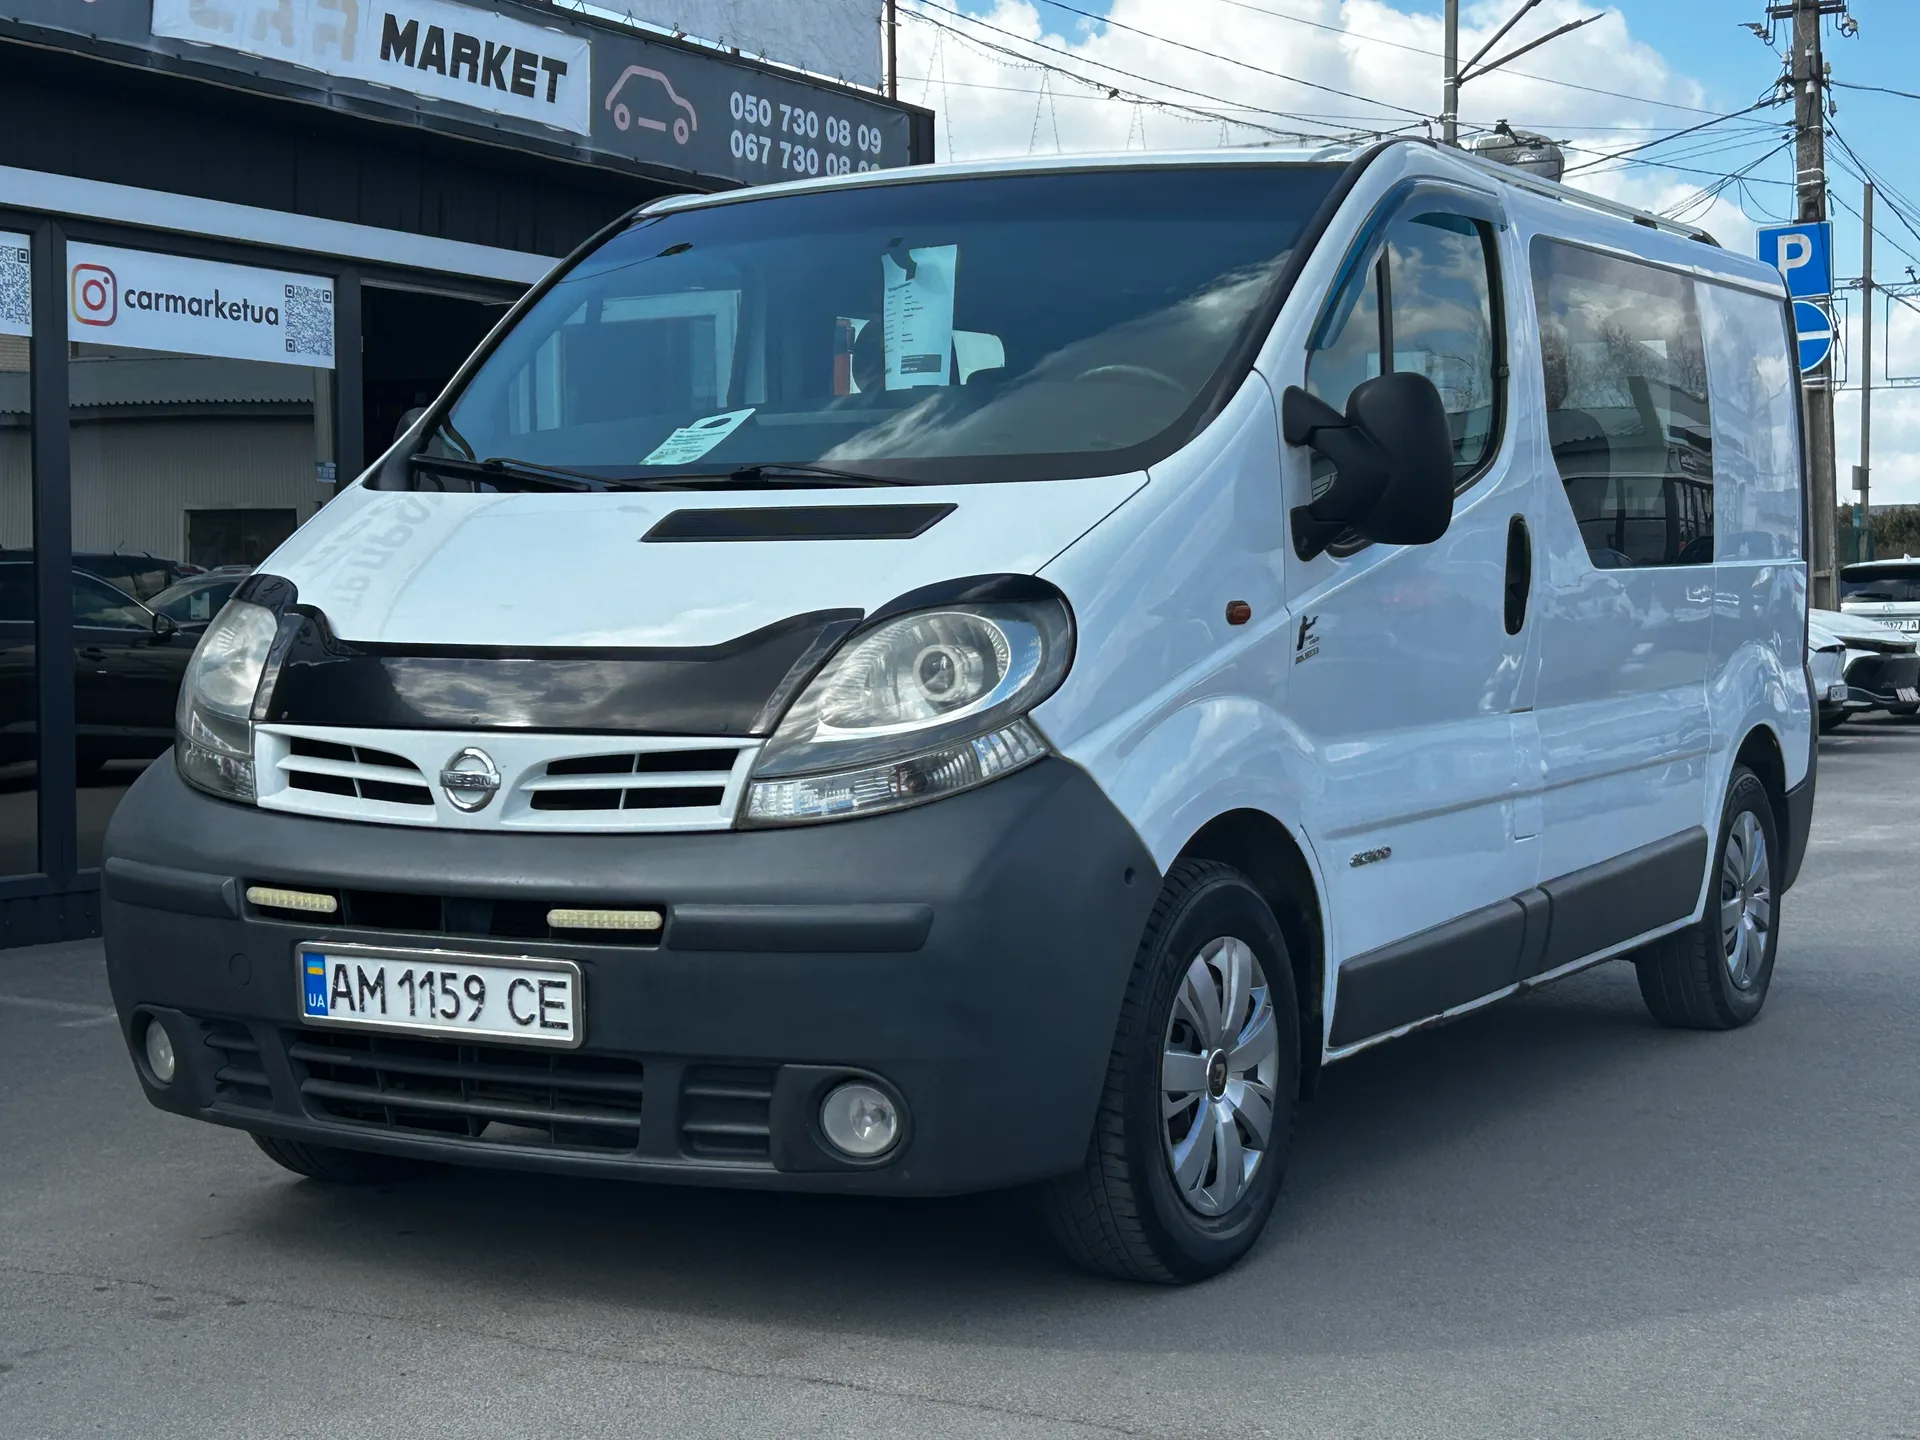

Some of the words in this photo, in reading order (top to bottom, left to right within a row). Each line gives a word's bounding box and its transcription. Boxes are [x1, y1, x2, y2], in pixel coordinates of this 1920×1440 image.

[380, 13, 568, 104] MARKET
[730, 91, 772, 127] 050
[779, 103, 819, 139] 730
[825, 116, 850, 147] 08
[857, 124, 882, 154] 09
[730, 129, 772, 164] 067
[779, 141, 819, 175] 730
[825, 152, 850, 177] 08
[1777, 233, 1812, 283] P
[124, 289, 279, 325] carmarketua
[308, 994, 326, 1008] UA
[329, 963, 387, 1014] AM
[397, 969, 486, 1022] 1159
[507, 978, 569, 1030] CE
